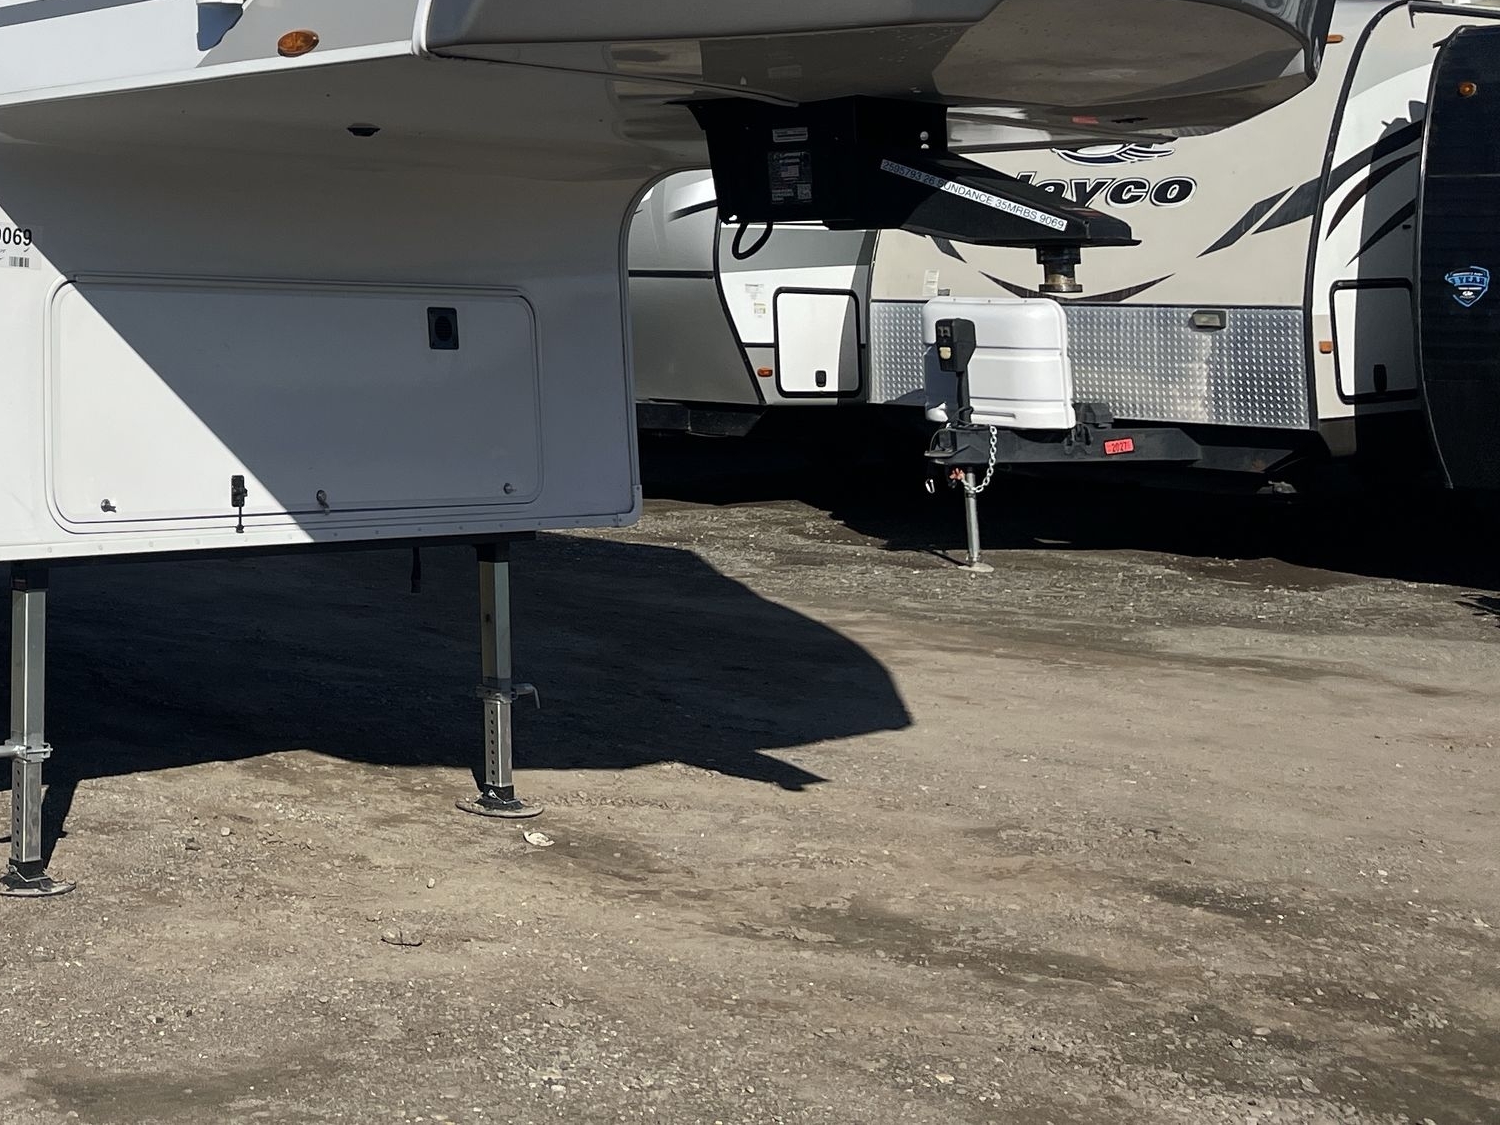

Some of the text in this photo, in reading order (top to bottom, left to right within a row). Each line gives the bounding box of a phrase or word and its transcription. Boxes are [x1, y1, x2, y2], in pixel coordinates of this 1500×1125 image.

[882, 160, 1065, 230] 2595793 26 SUNDANCE 35MRBS 9069
[1458, 276, 1485, 285] YEAR
[1111, 441, 1127, 452] 2027
